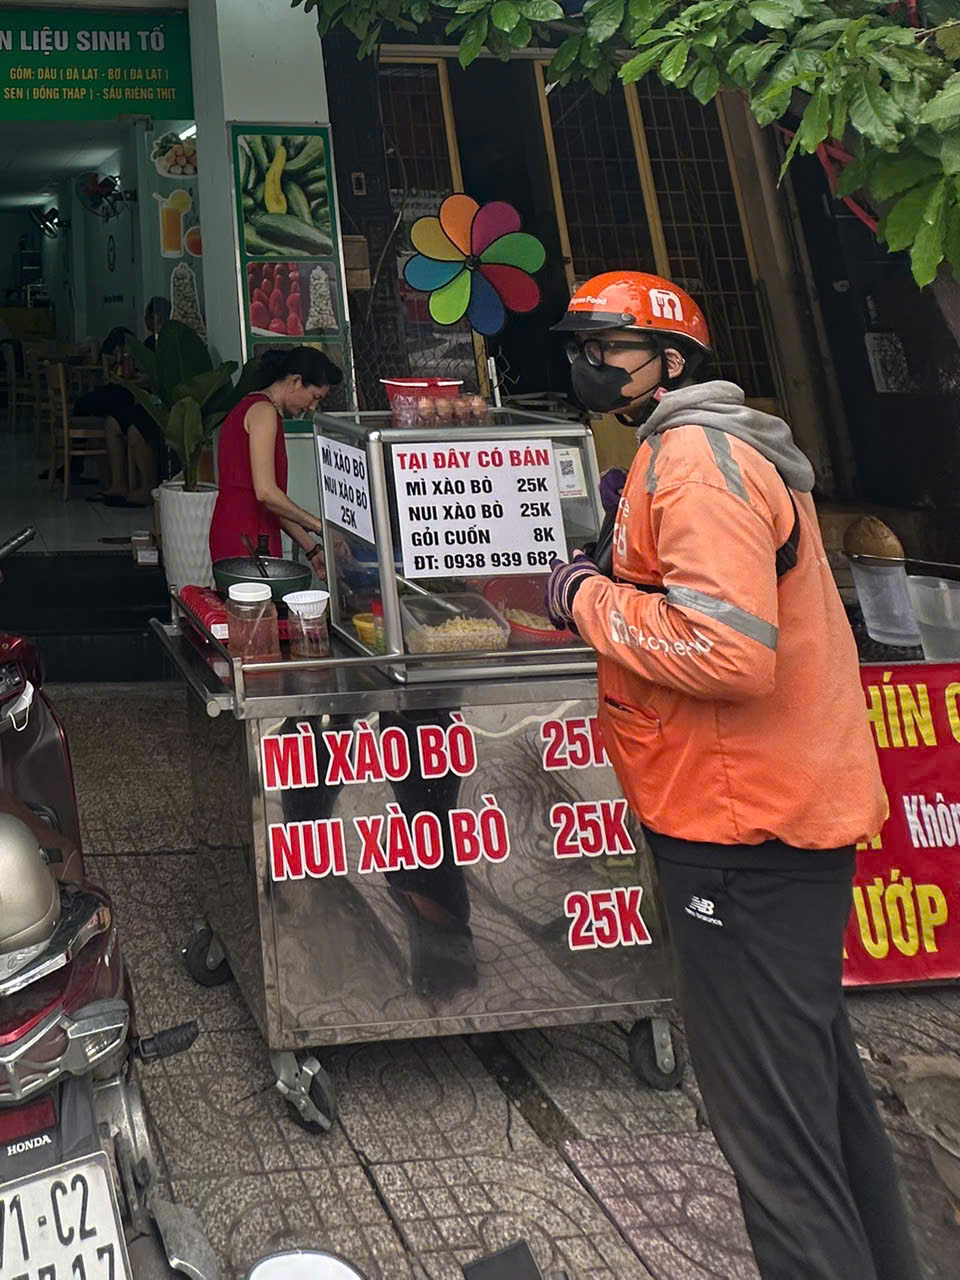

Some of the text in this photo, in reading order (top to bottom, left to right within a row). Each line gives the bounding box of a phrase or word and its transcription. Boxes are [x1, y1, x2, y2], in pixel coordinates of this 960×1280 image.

[20, 26, 69, 55] LIỆU
[76, 30, 131, 51] SINH
[137, 24, 166, 51] TỐ
[4, 87, 24, 100] SEN
[322, 444, 365, 480] MÌ XÀO BÒ
[397, 446, 550, 473] TẠI ĐÂY CÓ BÁN
[324, 475, 367, 510] NUI XÀO BÒ
[406, 475, 548, 496] MÌ XÀO BÒ 25K
[340, 505, 357, 529] 25K
[408, 500, 552, 521] NUI XÀO BÒ 25K
[411, 524, 555, 547] GỎI CUỐN 8K
[414, 554, 439, 570] ĐT:
[444, 553, 486, 569] 0938
[491, 552, 522, 567] 939
[858, 671, 938, 748] HÍN
[260, 721, 319, 791] MÌ
[322, 720, 411, 787] XÀO
[416, 711, 478, 779] BÒ
[268, 793, 637, 881] NUI XÀO BÒ 25K
[564, 885, 653, 950] 25K
[6, 1134, 52, 1156] HONDA
